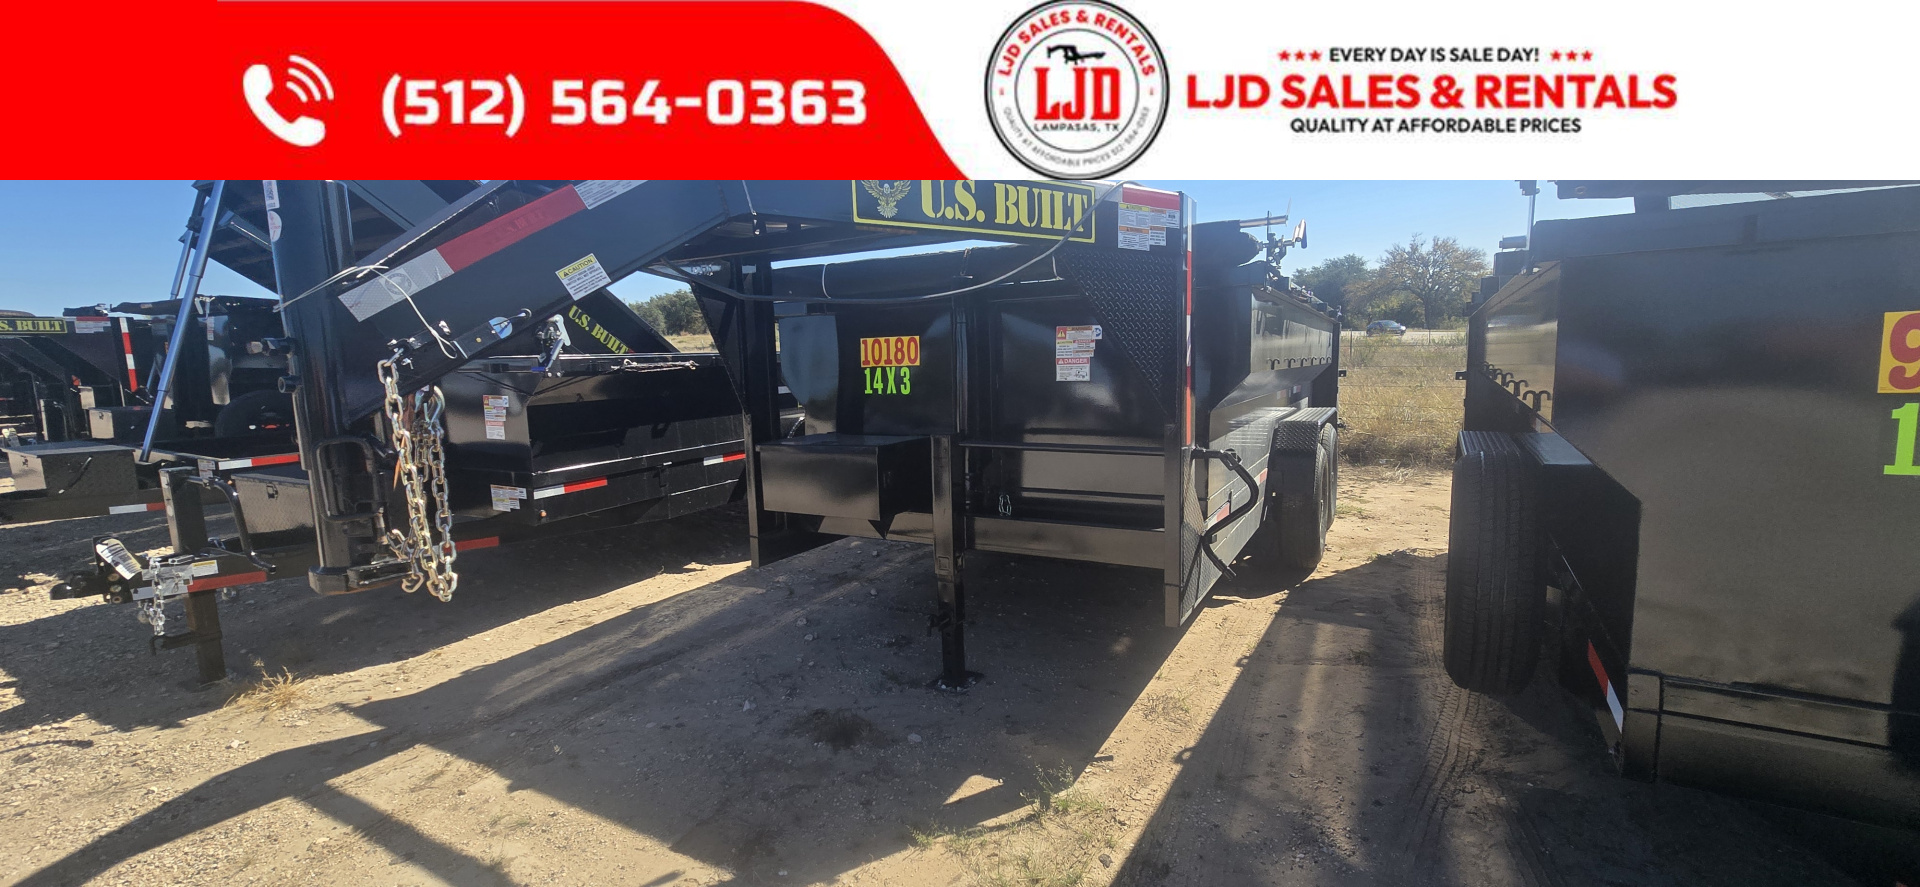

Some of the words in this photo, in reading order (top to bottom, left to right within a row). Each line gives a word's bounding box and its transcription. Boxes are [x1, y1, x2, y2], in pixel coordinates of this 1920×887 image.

[920, 180, 986, 223] U.S.
[994, 182, 1088, 232] BUILT
[567, 258, 593, 274] CAUTION
[15, 320, 62, 331] BUILT
[568, 304, 591, 331] U.S.
[590, 322, 629, 354] BUILT
[861, 336, 919, 366] 10180
[864, 367, 884, 395] 14
[900, 366, 911, 395] 3
